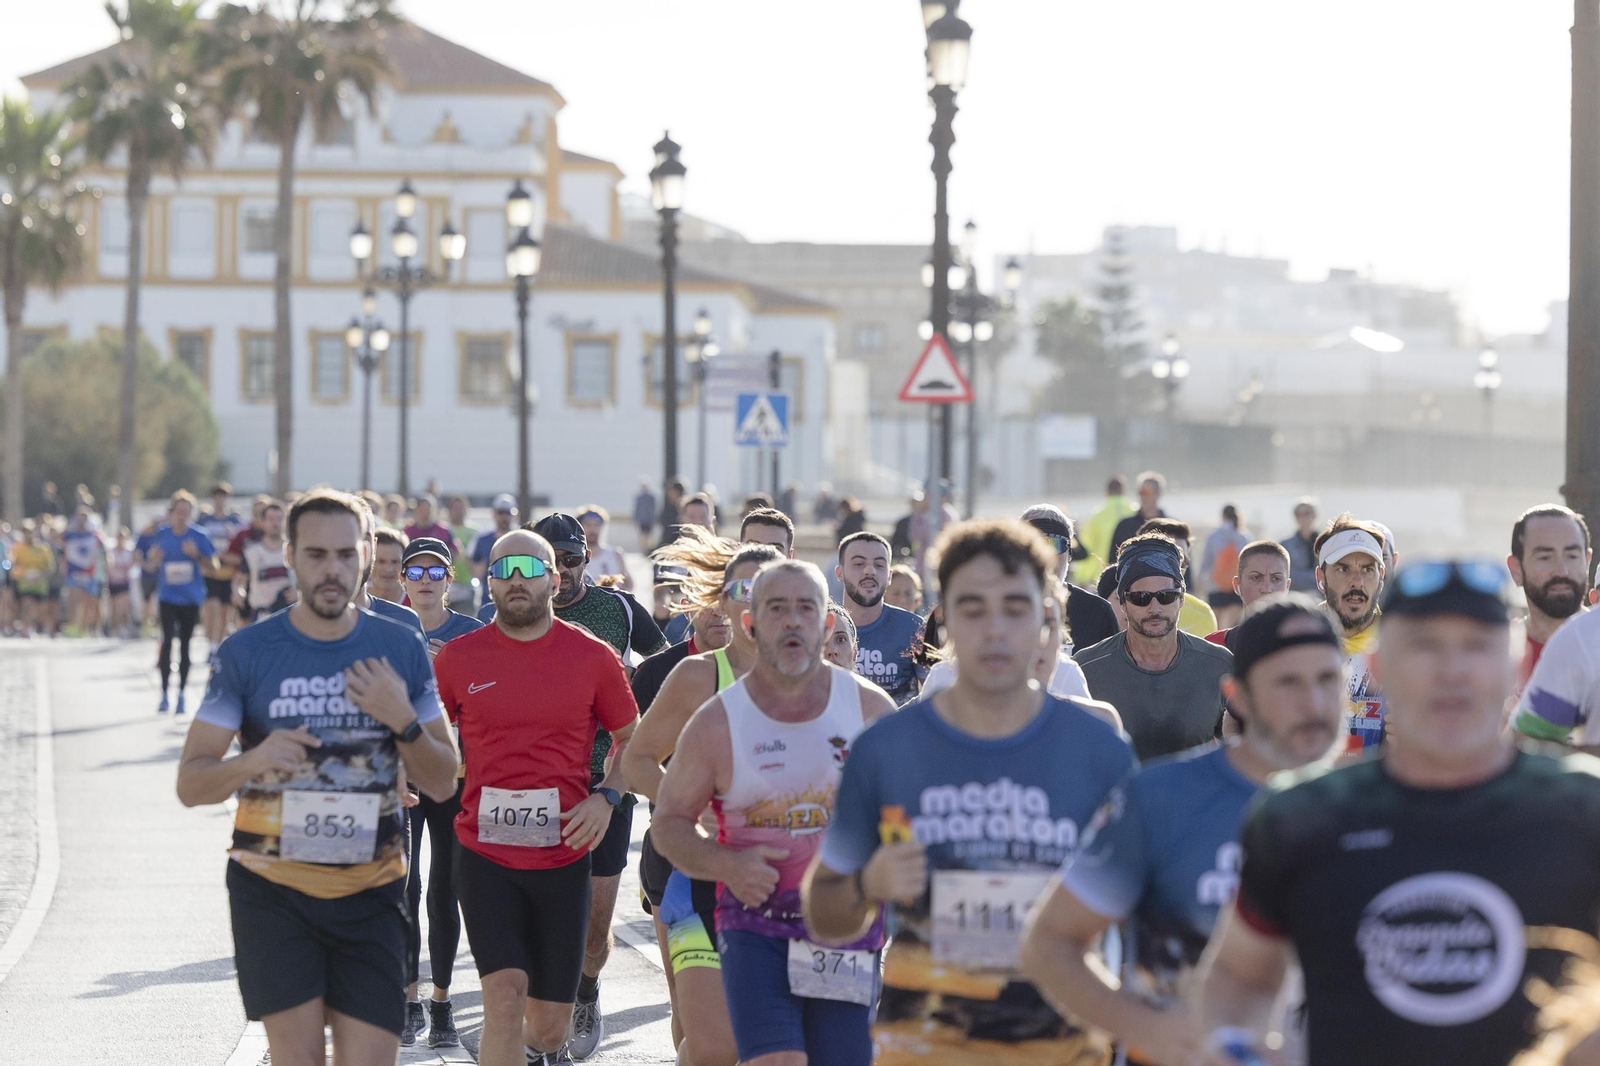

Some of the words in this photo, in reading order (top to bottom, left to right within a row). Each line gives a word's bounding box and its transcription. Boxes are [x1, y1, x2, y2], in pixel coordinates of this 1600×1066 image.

[856, 647, 883, 662] dia
[856, 662, 898, 676] aton
[280, 671, 347, 698] med
[304, 813, 355, 838] 853
[490, 806, 549, 827] 1075
[956, 900, 1034, 932] 111
[812, 950, 857, 976] 371
